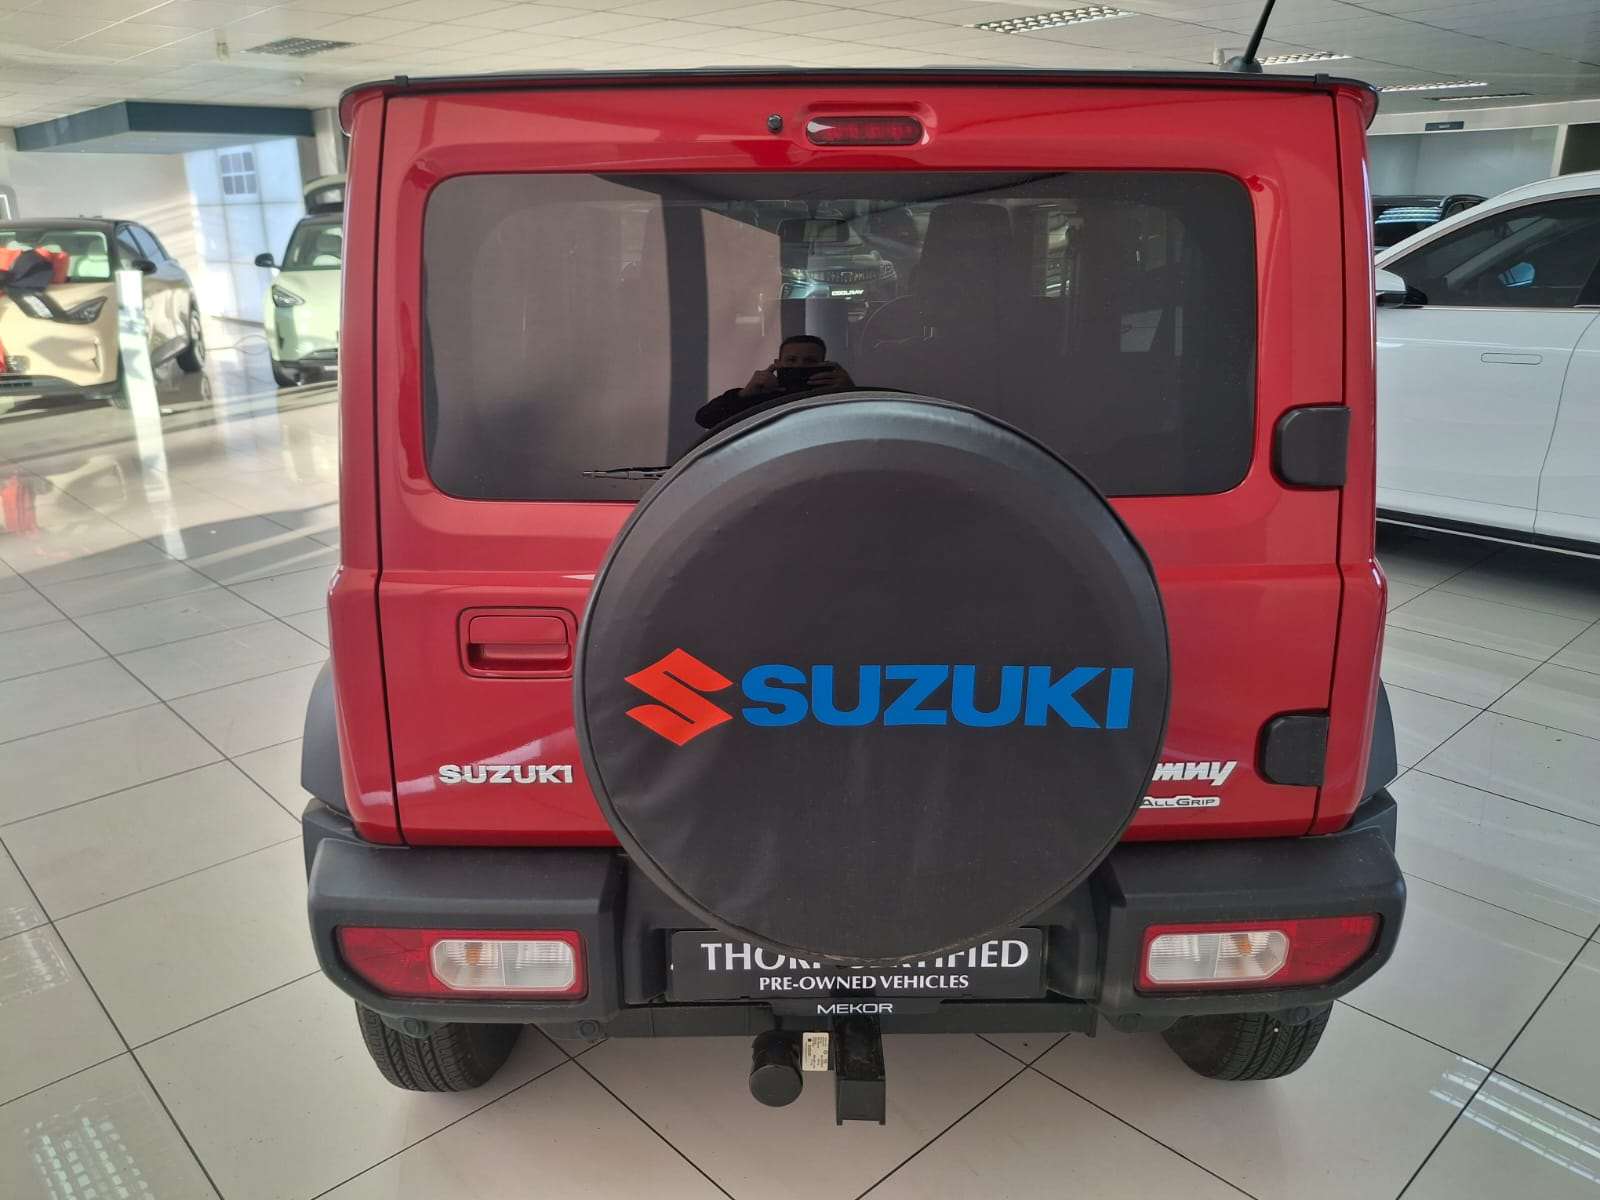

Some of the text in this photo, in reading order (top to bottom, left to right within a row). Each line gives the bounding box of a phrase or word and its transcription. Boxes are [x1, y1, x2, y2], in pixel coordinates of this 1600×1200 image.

[741, 664, 1135, 729] SUZUKI
[438, 764, 574, 784] SUZUKI
[1151, 761, 1238, 786] mny
[759, 974, 970, 991] PRE-OWNED VEHICLES
[817, 1002, 894, 1015] MEKOR
